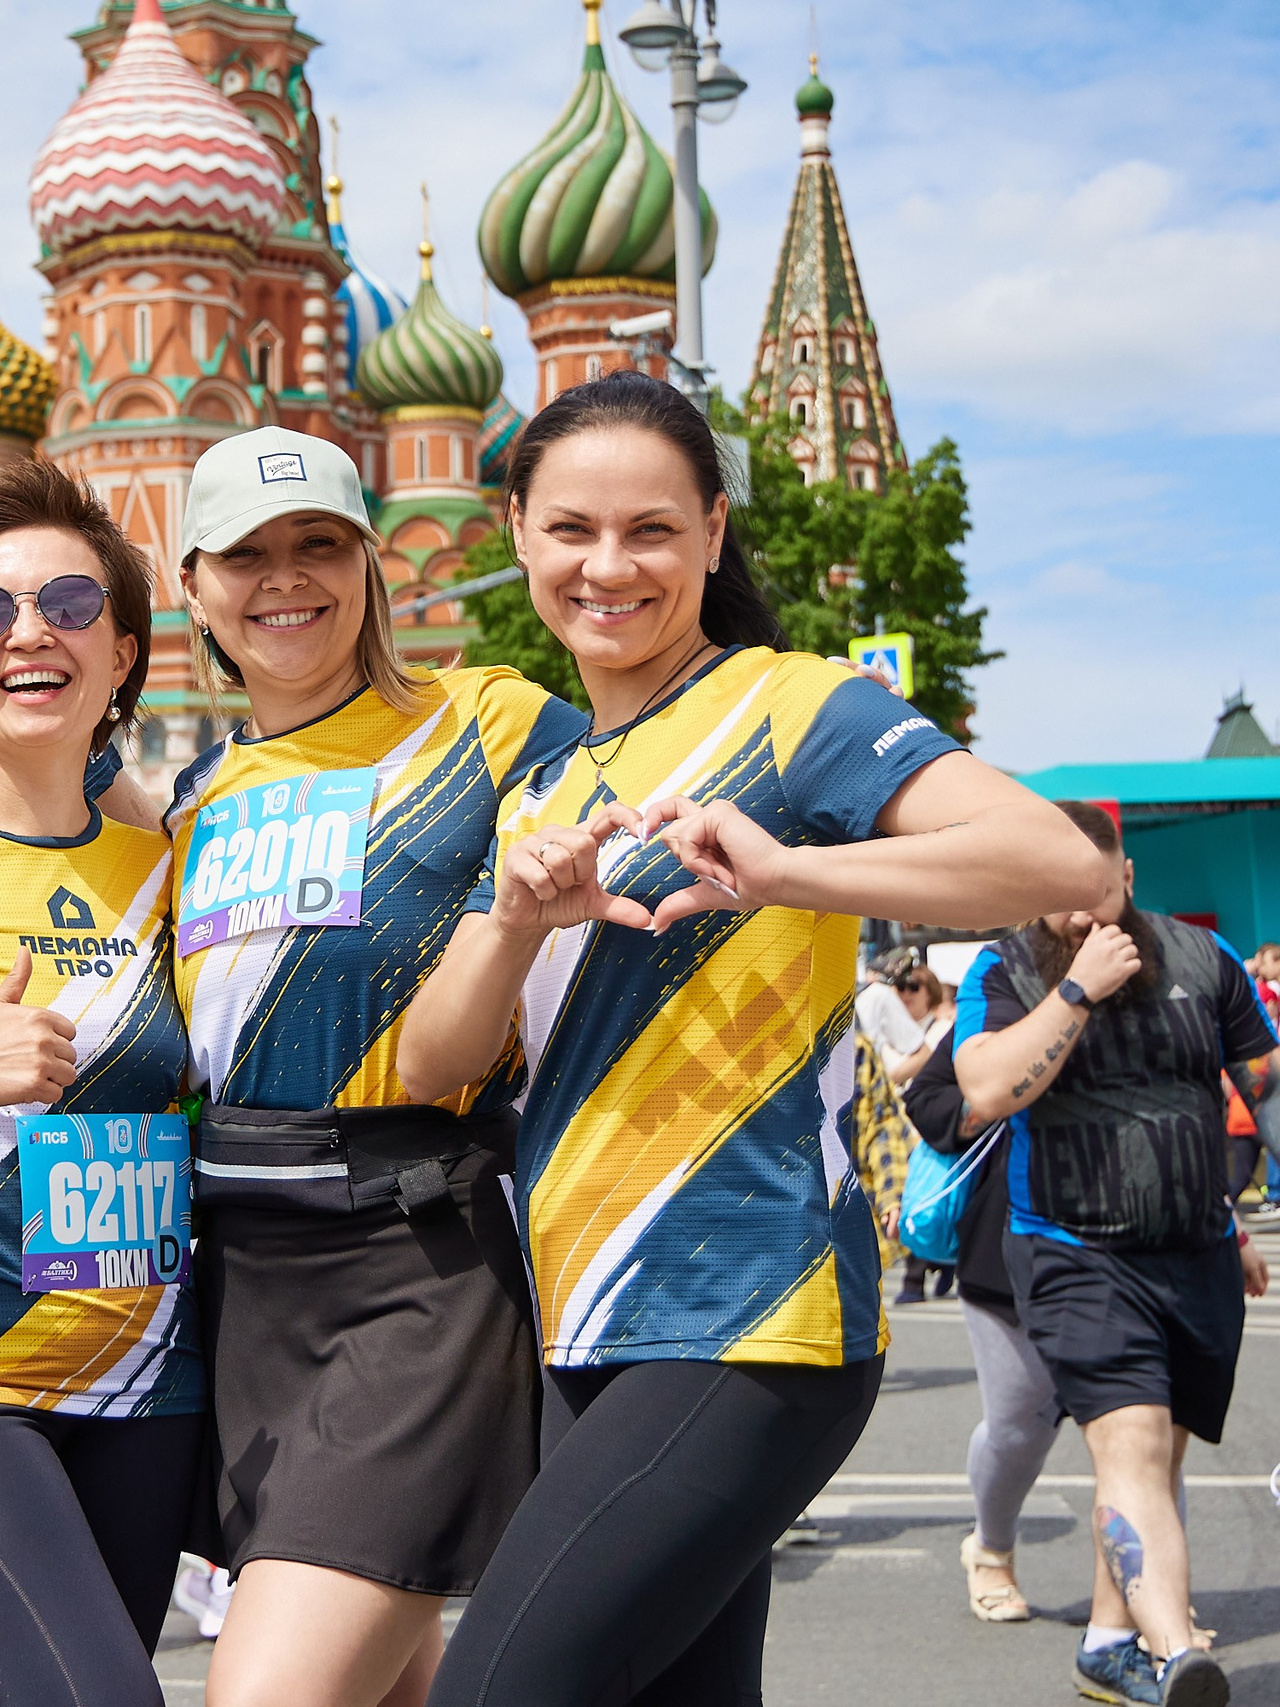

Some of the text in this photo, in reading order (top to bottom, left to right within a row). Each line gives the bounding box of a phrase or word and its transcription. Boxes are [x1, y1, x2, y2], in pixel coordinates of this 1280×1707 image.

[872, 717, 939, 757] ЛЕМАН
[192, 810, 350, 911] 62010
[296, 877, 333, 913] D
[18, 935, 138, 956] ЛЕМАНА
[53, 958, 113, 978] ПРО
[42, 1131, 69, 1145] ПСБ
[104, 1118, 133, 1154] 10
[48, 1160, 175, 1245] 62117
[159, 1234, 180, 1274] D
